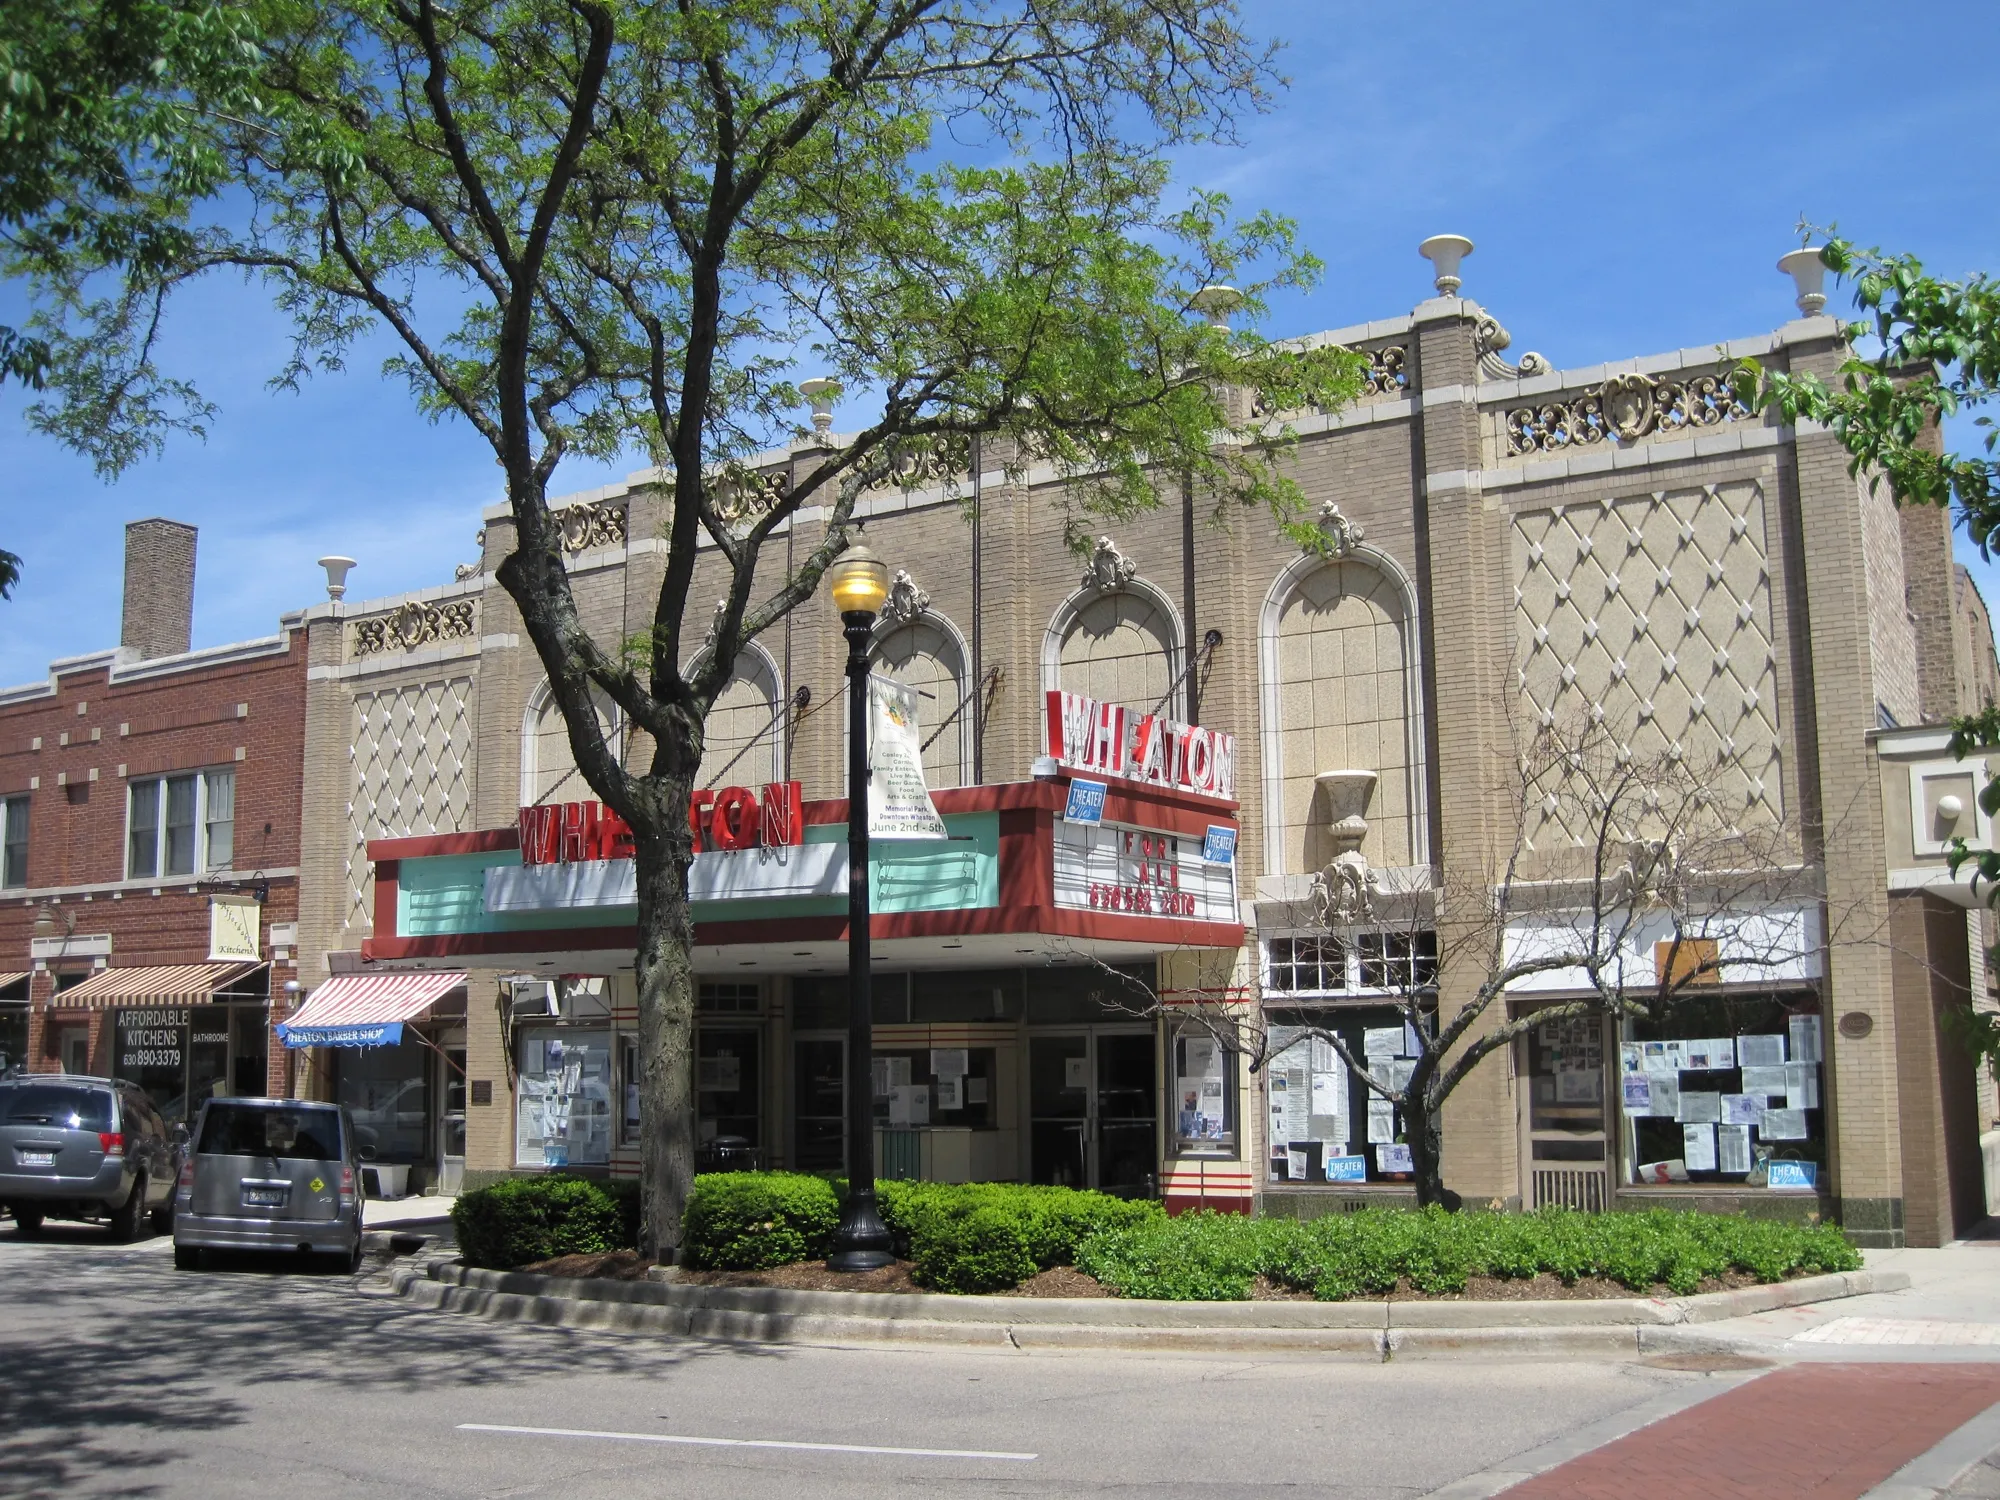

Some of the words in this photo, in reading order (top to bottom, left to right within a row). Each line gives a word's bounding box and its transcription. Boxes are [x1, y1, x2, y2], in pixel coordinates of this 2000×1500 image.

[1046, 691, 1235, 800] WHEATON
[1072, 788, 1103, 807] THEATER
[885, 804, 914, 812] Memorial
[518, 781, 802, 864] WHETON
[871, 822, 897, 832] June
[900, 822, 919, 832] 2nd
[928, 822, 944, 832] 5th
[1124, 831, 1166, 860] FOR
[1207, 834, 1233, 851] THEATER
[1089, 882, 1121, 910] 630
[219, 901, 254, 950] Affordable
[219, 944, 254, 955] Kitchens
[118, 1009, 189, 1027] AFFORDABLE
[127, 1029, 178, 1046] KITCHENS
[327, 1029, 358, 1042] BARBER
[359, 1028, 384, 1040] SHOP
[123, 1053, 137, 1066] 630
[137, 1049, 181, 1066] 890-3379
[1330, 1161, 1362, 1172] THEATER
[1772, 1166, 1812, 1177] THEATER
